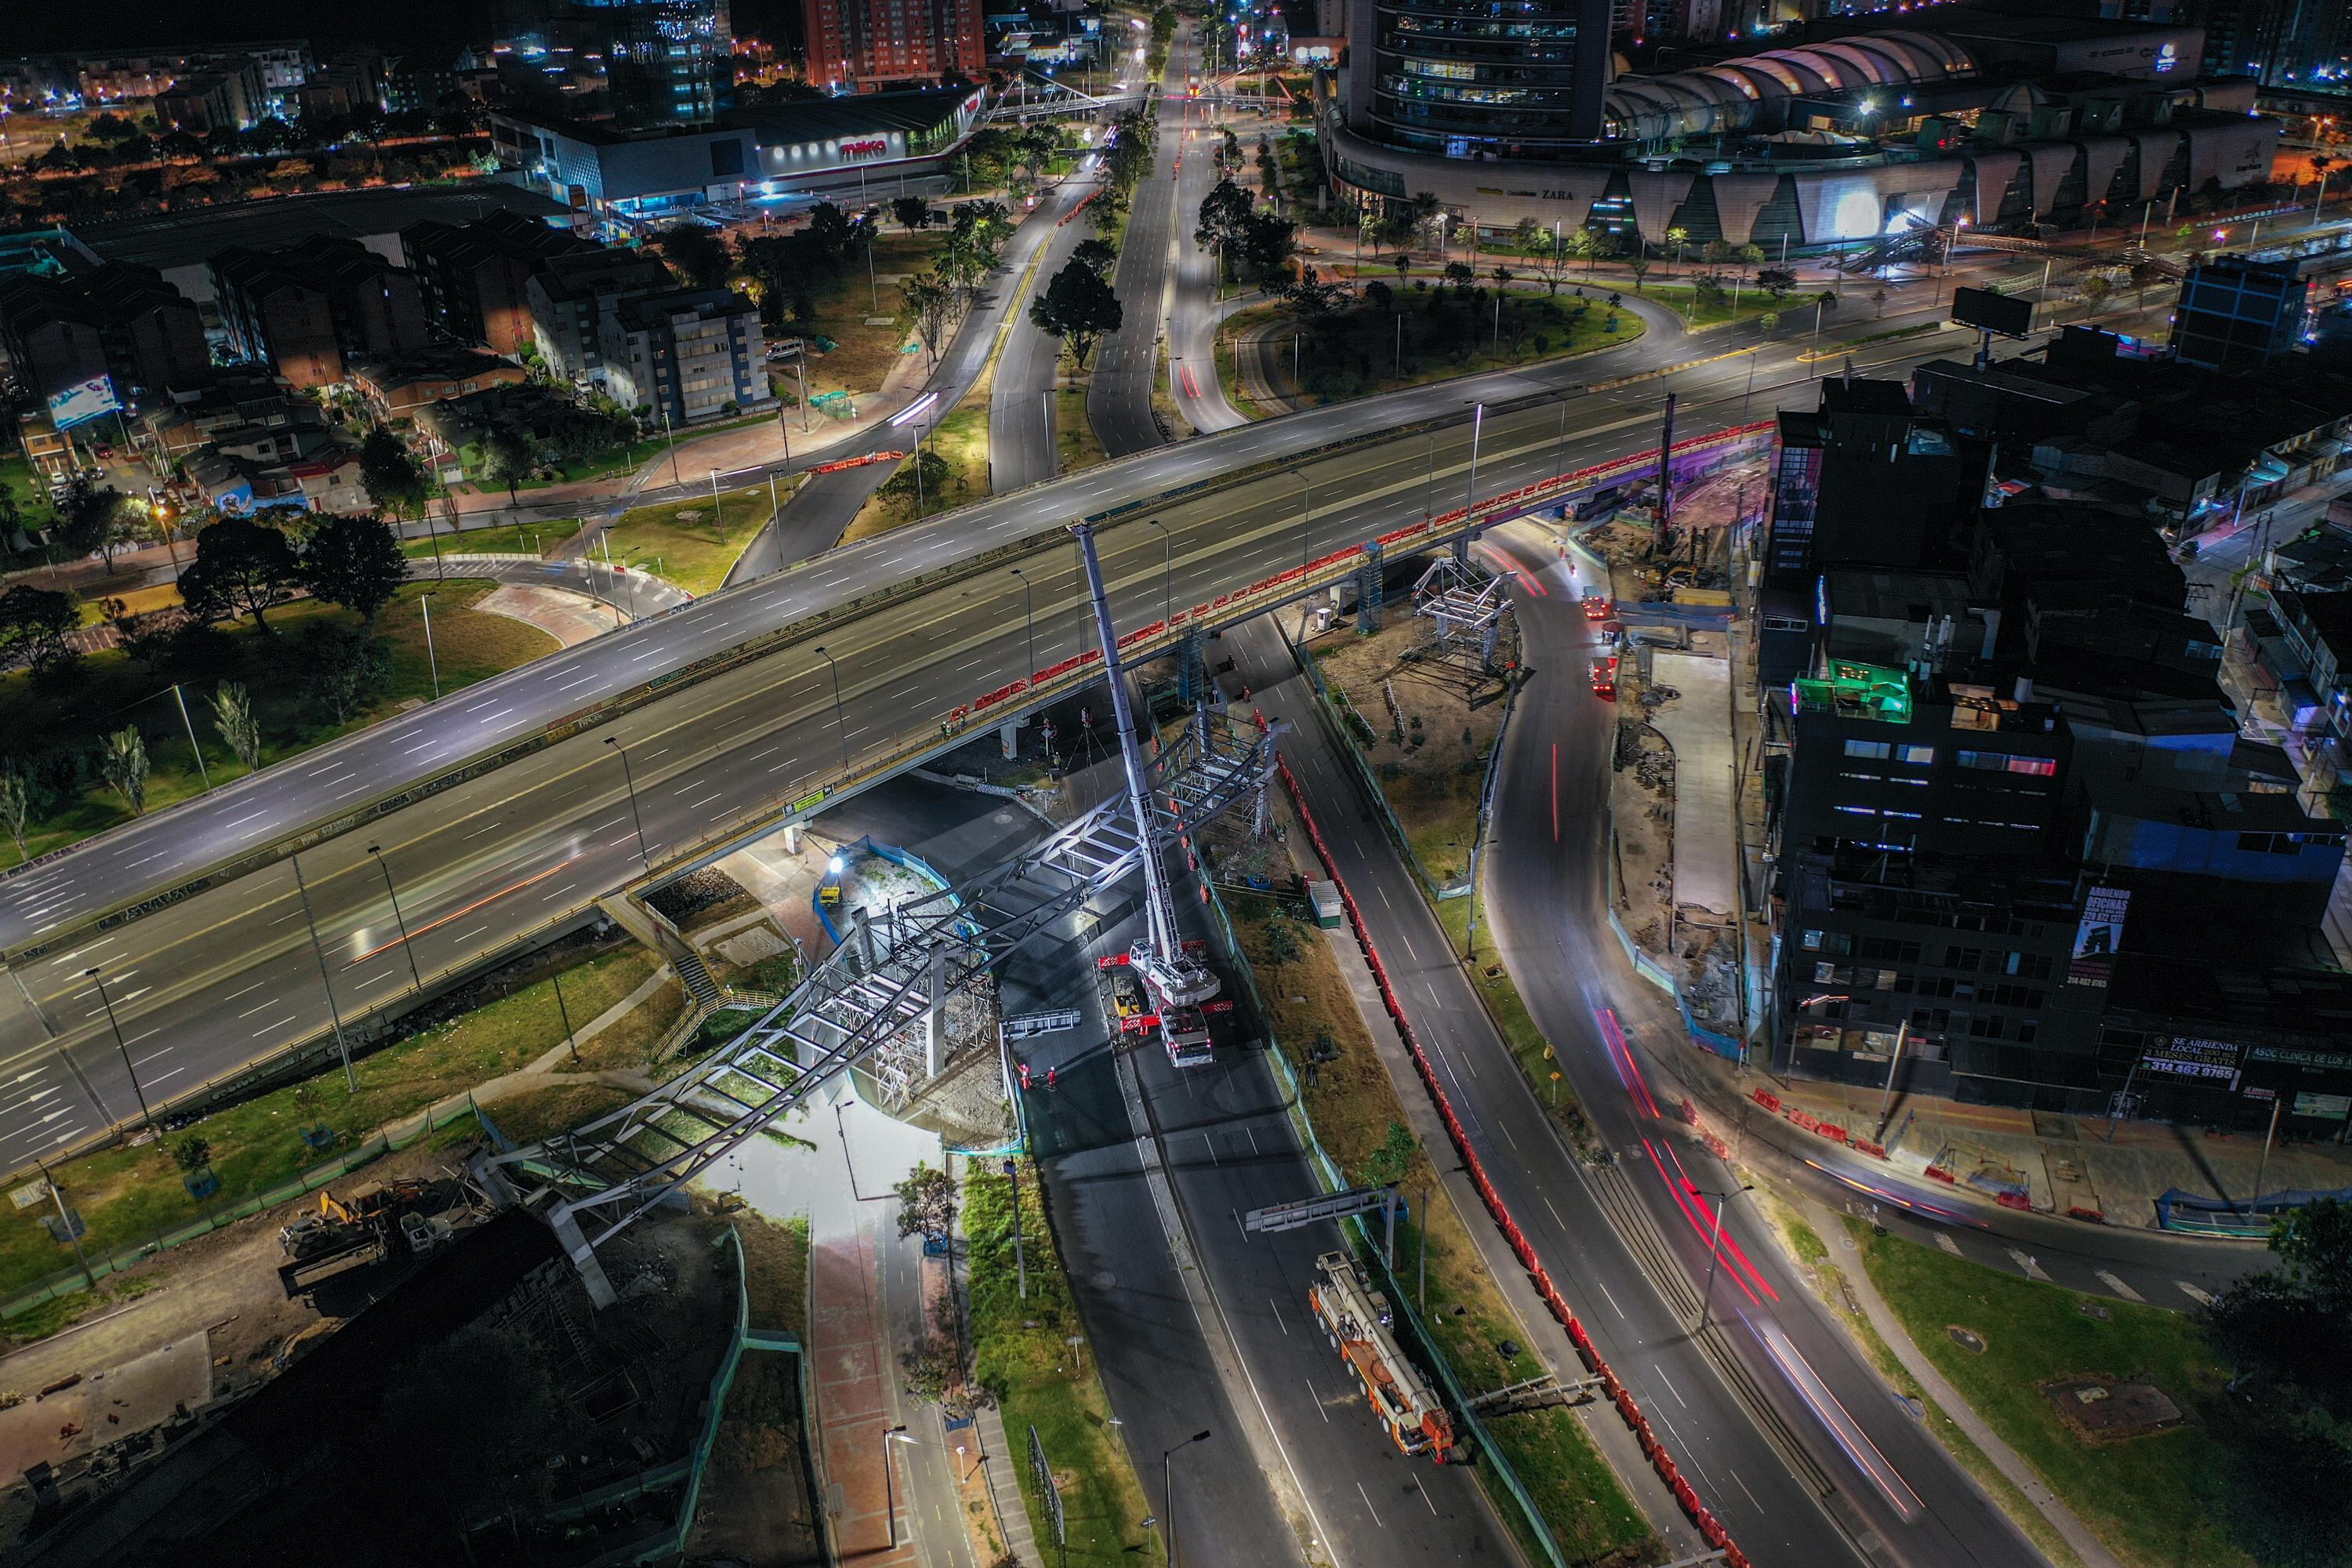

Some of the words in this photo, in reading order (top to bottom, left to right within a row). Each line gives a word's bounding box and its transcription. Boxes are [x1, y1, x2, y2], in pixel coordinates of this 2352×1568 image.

[1543, 190, 1573, 200] ZARA
[2089, 887, 2131, 899] ARRIENDO
[2086, 896, 2129, 910] OFICINAS
[2170, 1044, 2203, 1054] LOCAL
[2188, 1040, 2238, 1051] ARRIENDA
[2154, 1050, 2193, 1061] MESES
[2195, 1054, 2236, 1065] GRATIS
[2253, 1047, 2278, 1058] ASOC
[2280, 1050, 2311, 1062] CLINICA
[2314, 1054, 2325, 1063] DE
[2327, 1056, 2343, 1065] LOS
[2151, 1062, 2174, 1071] 314
[2175, 1065, 2200, 1075] 462
[2201, 1067, 2233, 1080] 9765
